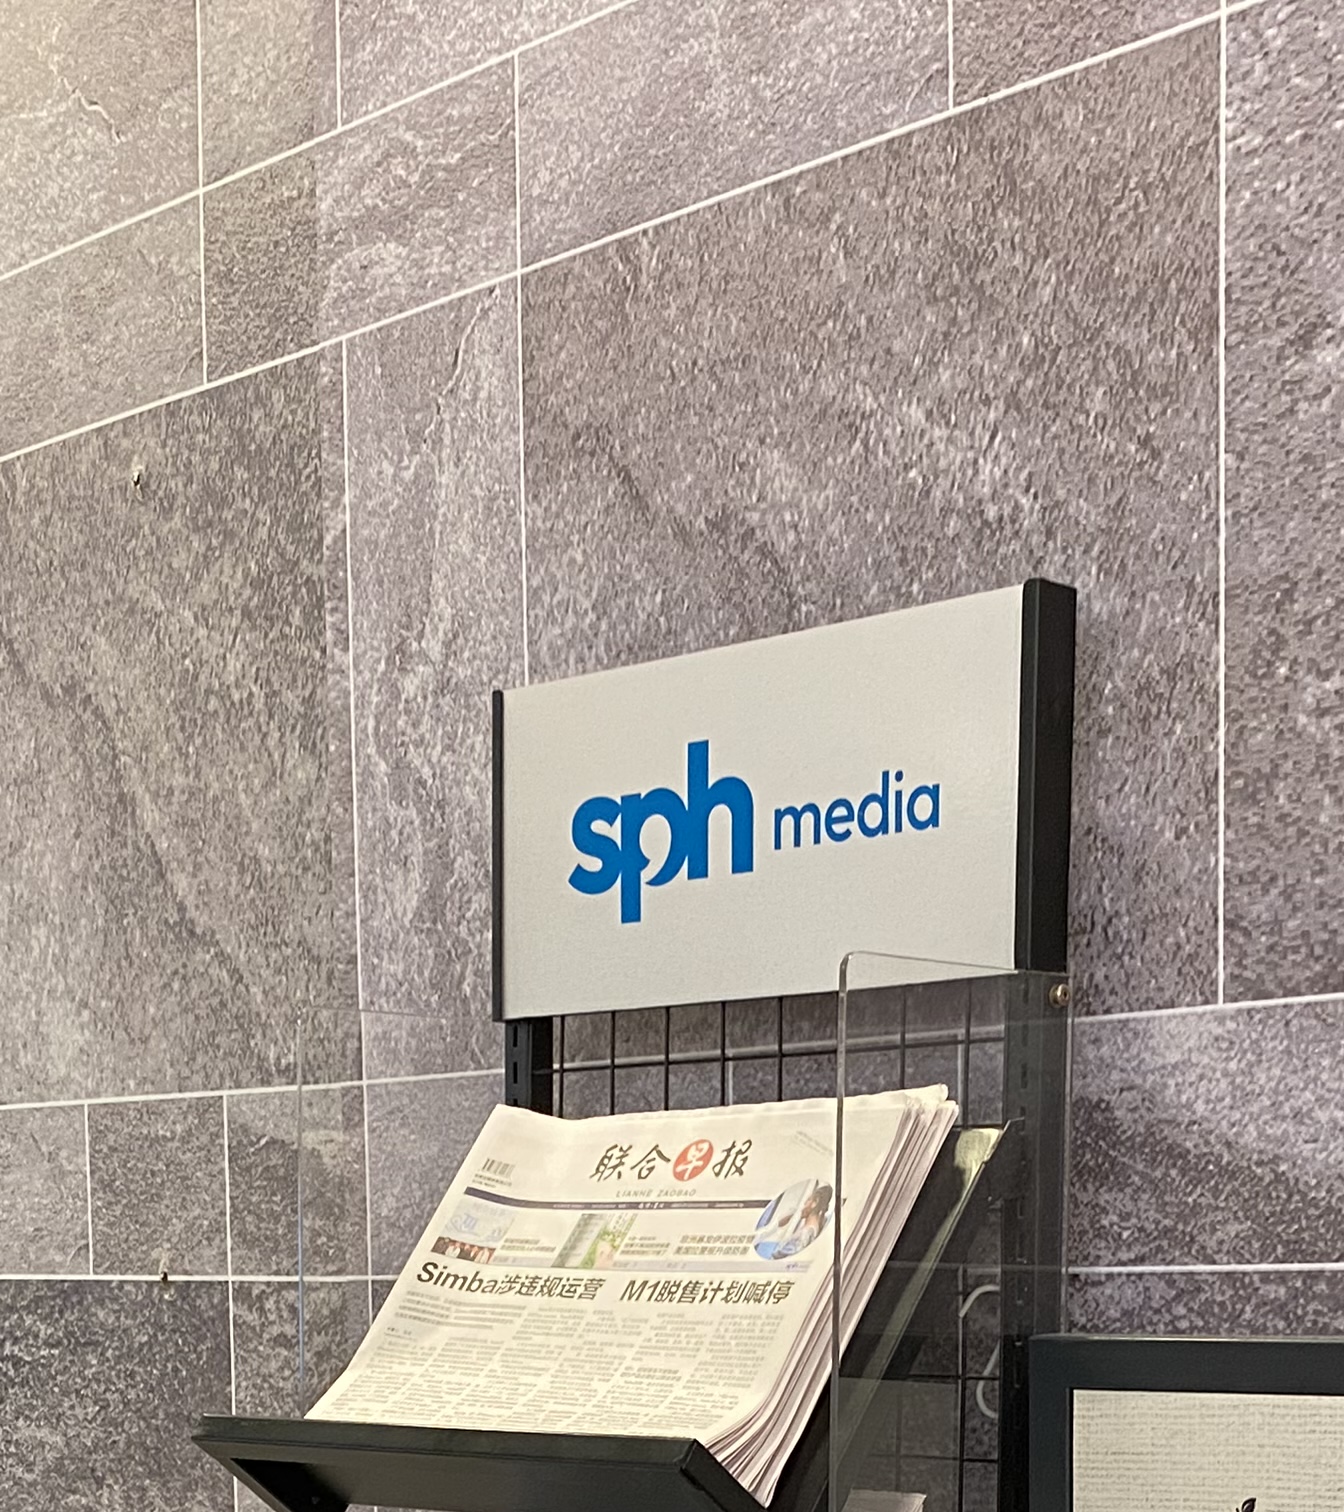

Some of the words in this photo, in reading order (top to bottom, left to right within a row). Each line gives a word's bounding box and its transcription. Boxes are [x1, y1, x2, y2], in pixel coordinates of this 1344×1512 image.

[568, 739, 754, 924] sph
[774, 769, 941, 851] media
[589, 1138, 753, 1183] 联合早报
[416, 1261, 606, 1301] Simba涉违规运营
[619, 1278, 794, 1305] M1脱售计划喊停
